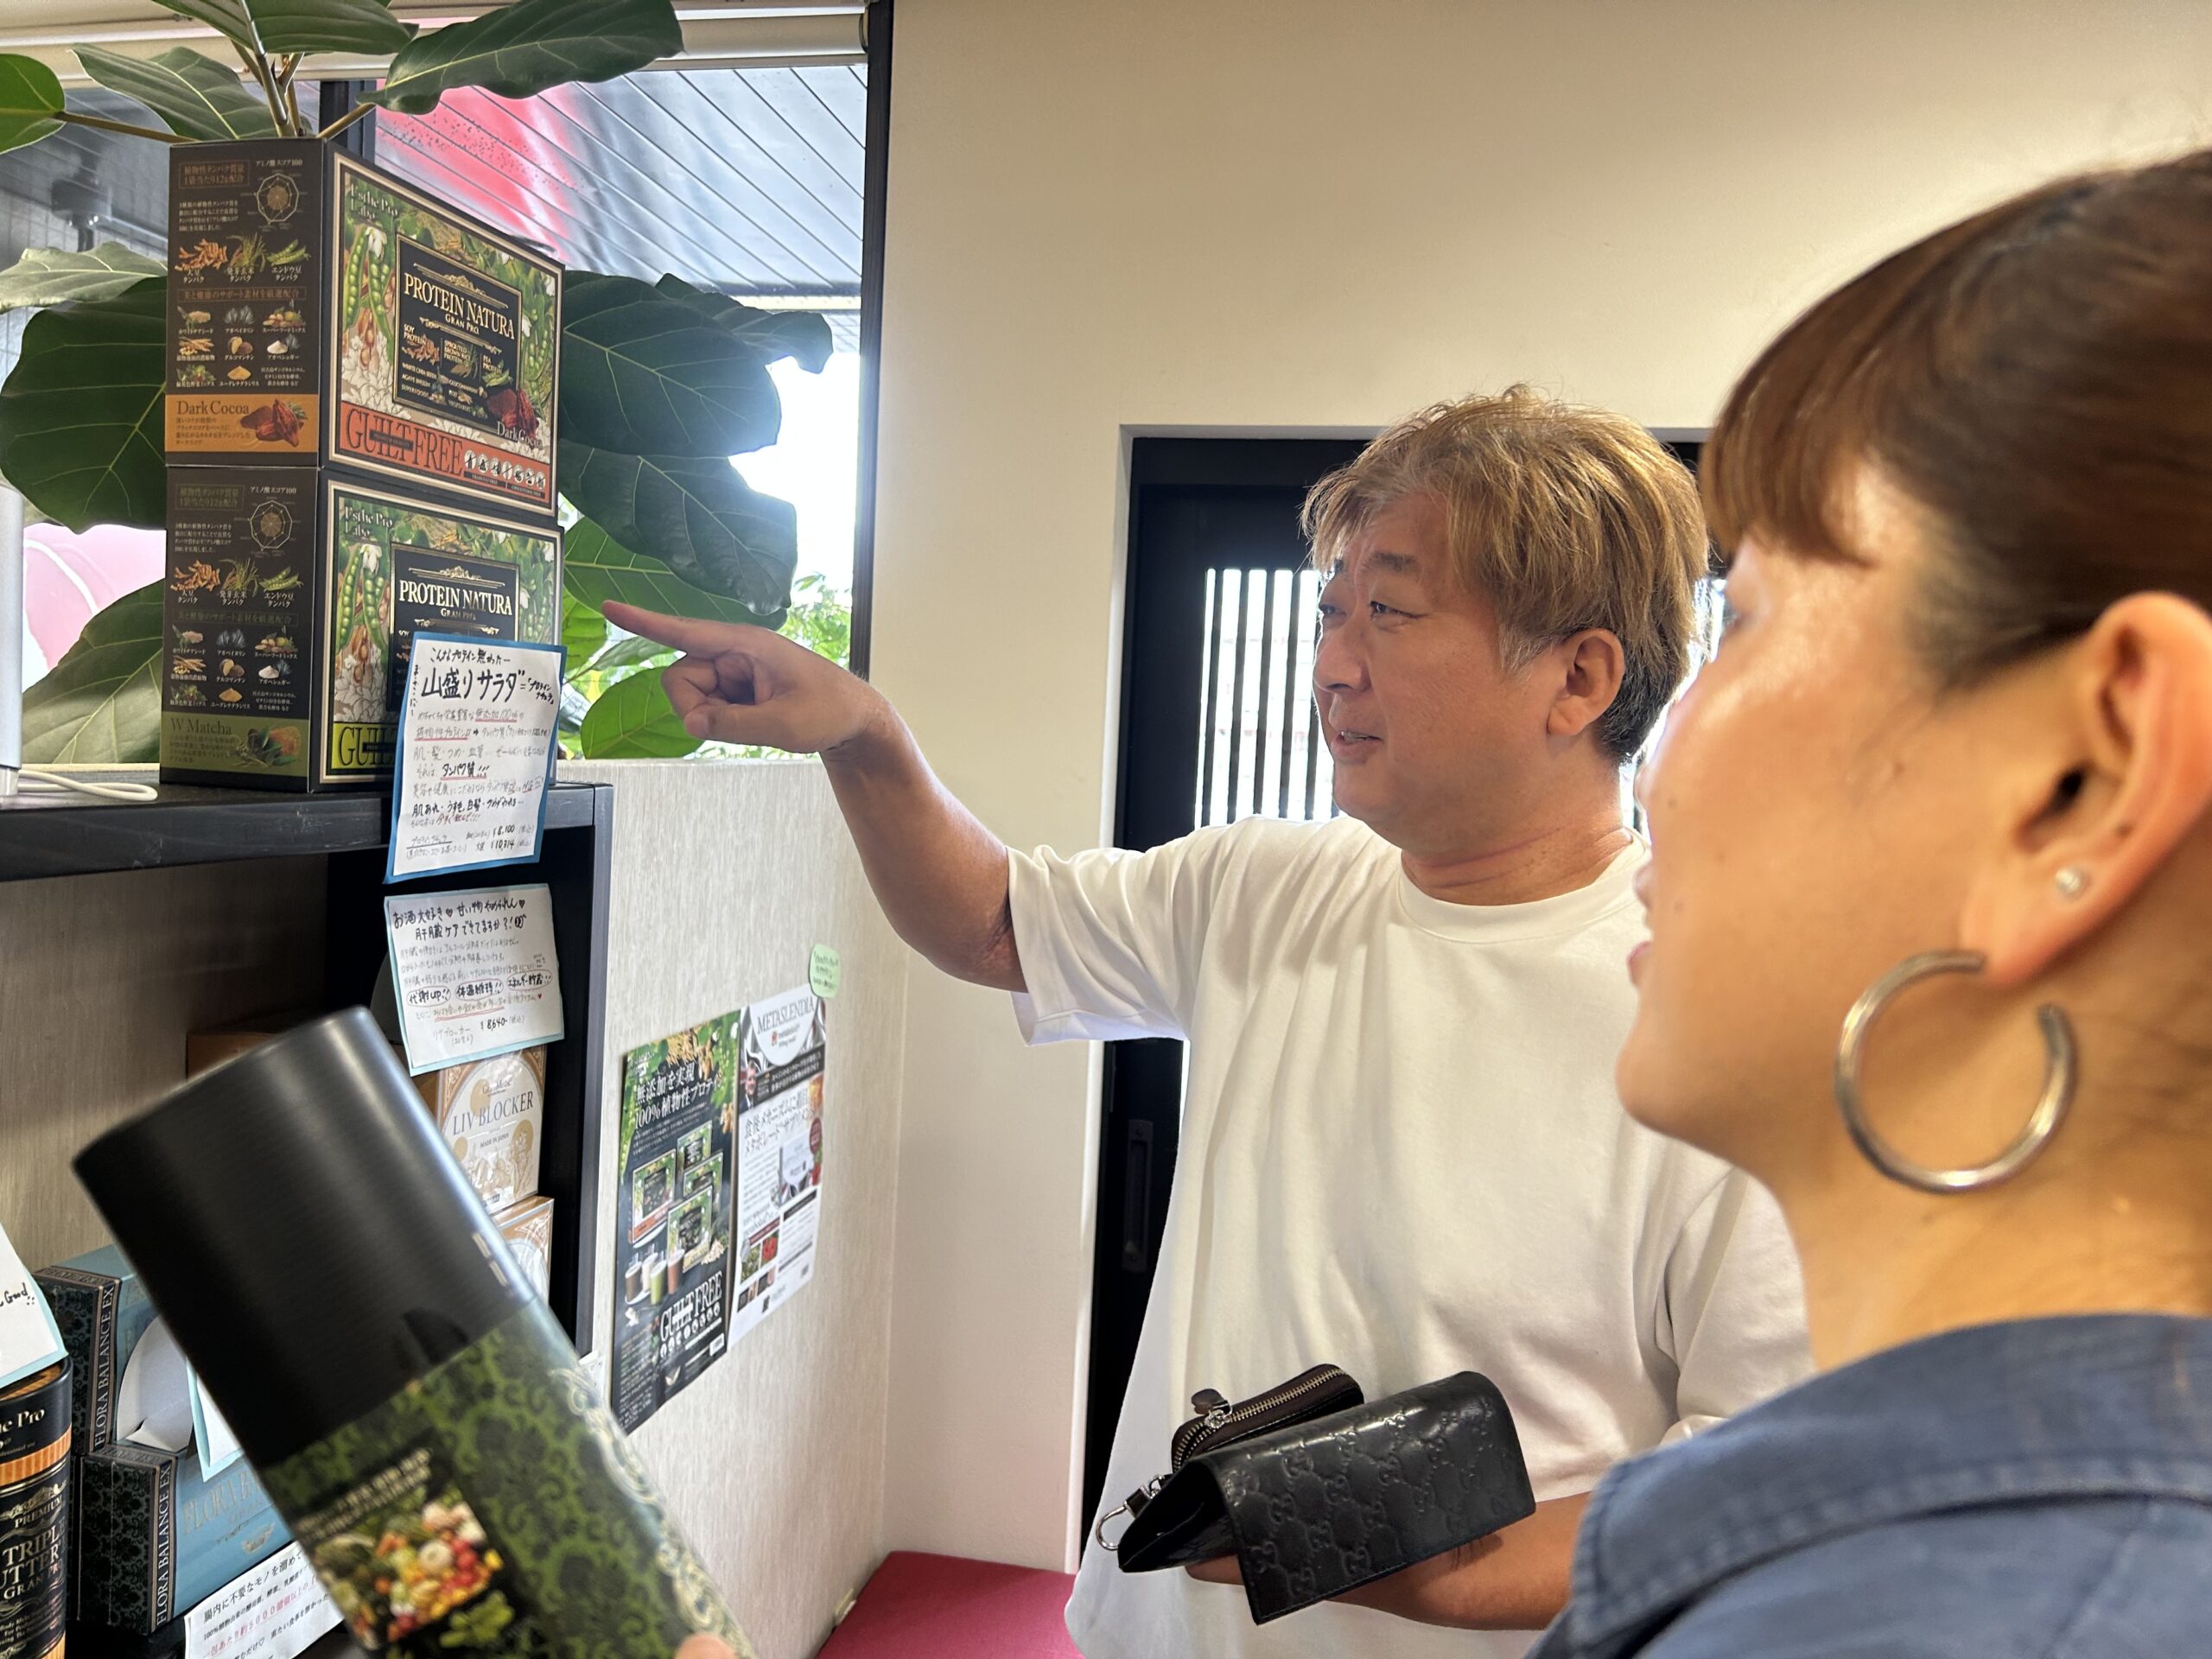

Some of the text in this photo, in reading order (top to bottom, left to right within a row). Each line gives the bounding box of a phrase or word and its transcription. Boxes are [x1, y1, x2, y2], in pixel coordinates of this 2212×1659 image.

[404, 272, 515, 340] PROTEIN NATURA
[404, 323, 415, 334] SOY
[445, 313, 465, 328] GRAN
[404, 332, 426, 346] PROTEIN
[483, 362, 503, 374] PROTEIN
[177, 400, 250, 416] Dark Cocoa
[346, 408, 463, 476] GUILT FREE
[497, 421, 543, 450] Dark Cocoa
[345, 507, 393, 528] Esthe Pro
[345, 524, 371, 537] Labo
[398, 579, 513, 616] PROTEIN NATURA
[171, 718, 232, 734] W Matcha
[338, 727, 397, 766] GUIL
[453, 1090, 533, 1135] LIV BLOCKER
[480, 1139, 492, 1147] MADE
[498, 1133, 509, 1142] JAPAN
[695, 1270, 722, 1317] FREE
[95, 1284, 114, 1446] FLORA BALANCE EX
[17, 1409, 45, 1427] Pro
[15, 1495, 63, 1528] PREMIUM
[3, 1516, 66, 1567] TRIPLE
[157, 1465, 171, 1625] FLORA BALANCE EX
[3, 1578, 44, 1599] GRAN
